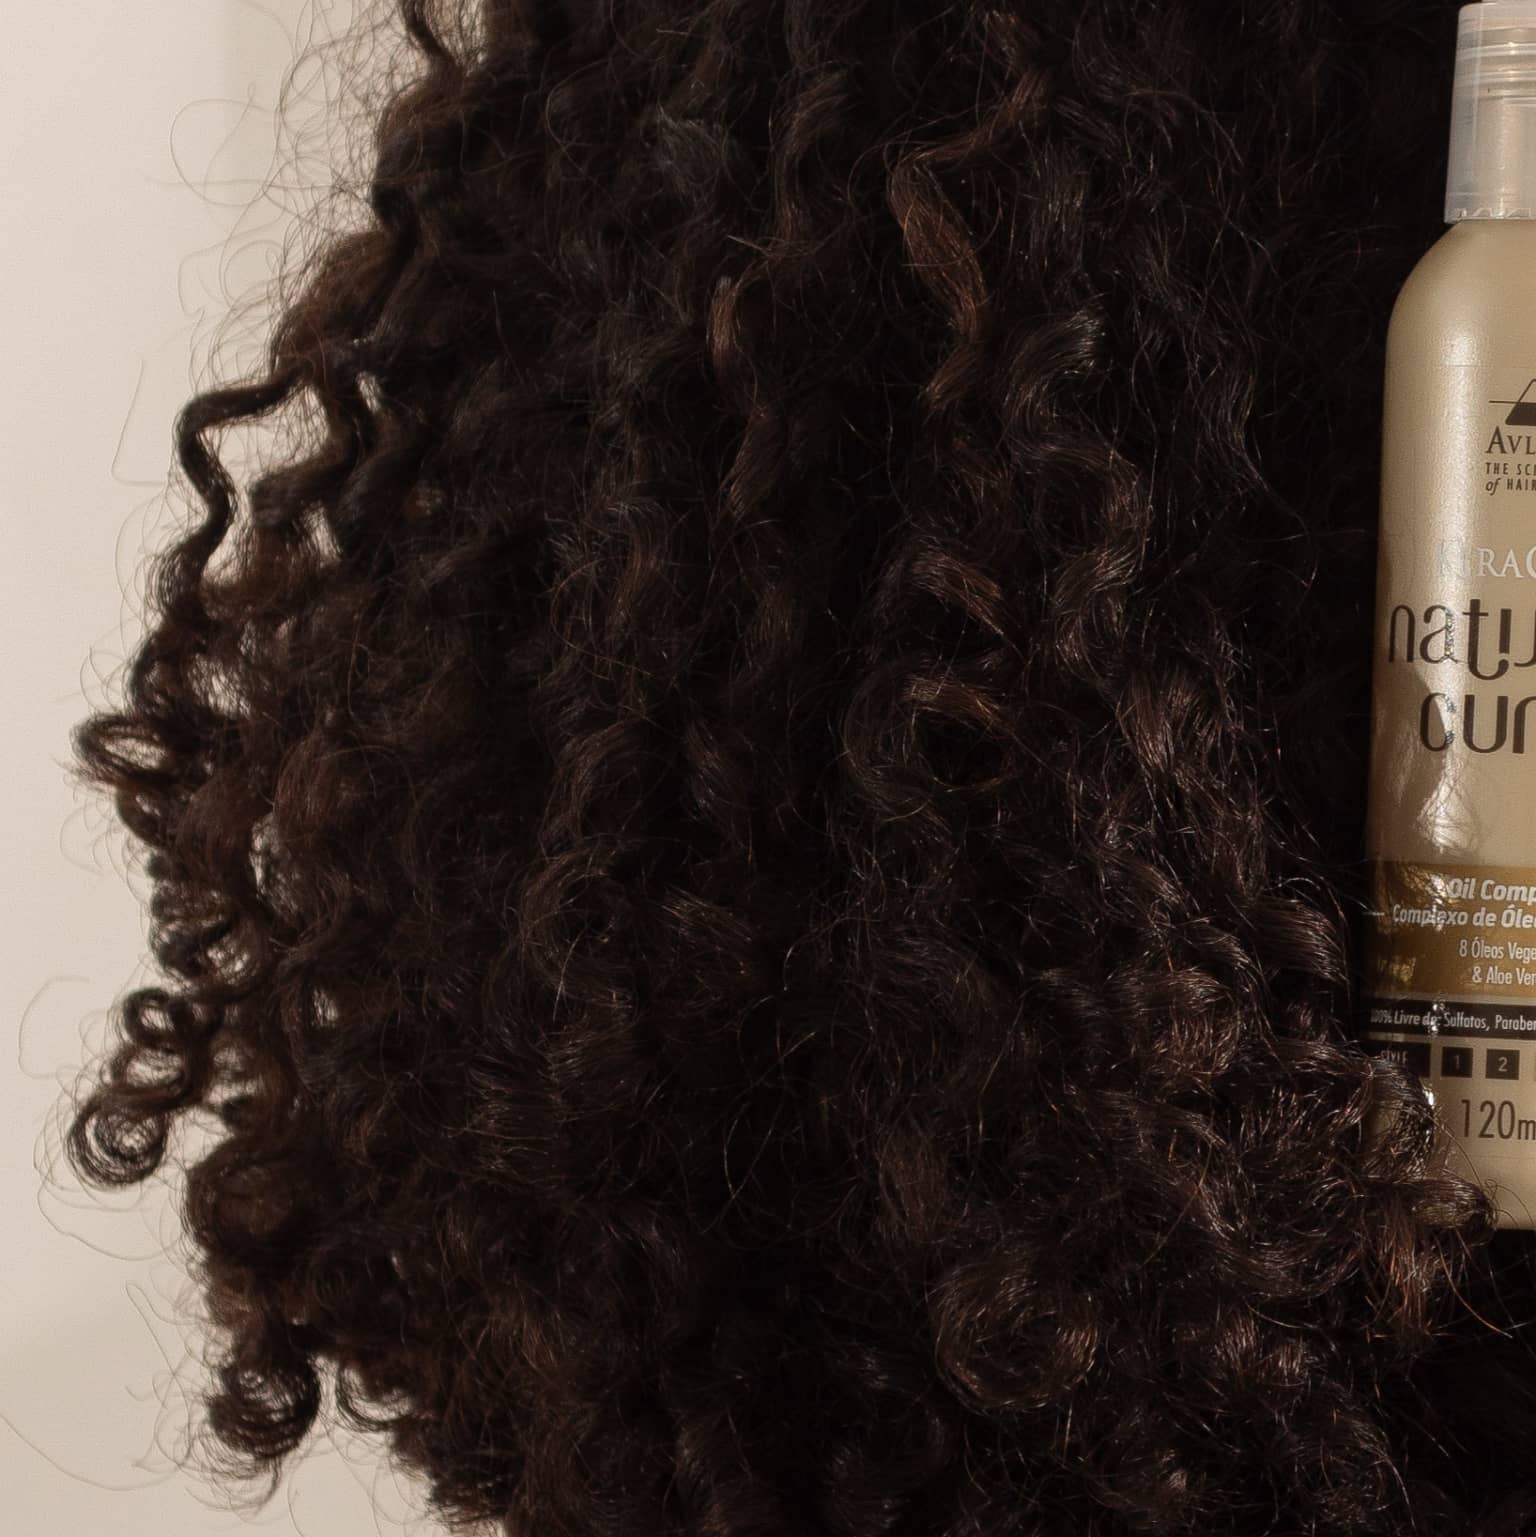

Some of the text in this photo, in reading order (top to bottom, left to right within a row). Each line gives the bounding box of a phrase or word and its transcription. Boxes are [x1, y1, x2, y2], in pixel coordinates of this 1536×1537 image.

[1485, 462, 1509, 475] THE
[1485, 477, 1501, 496] of
[1447, 877, 1475, 901] Oil
[1392, 904, 1468, 927] Complexo
[1472, 907, 1497, 928] de
[1459, 939, 1468, 957] 8
[1471, 936, 1504, 960] Óleos
[1472, 966, 1482, 983] &
[1486, 967, 1513, 985] Aloe
[1394, 1009, 1421, 1025] Livre
[1443, 1010, 1490, 1031] Sulfatos,
[1453, 1055, 1460, 1069] 1
[1498, 1057, 1508, 1072] 2
